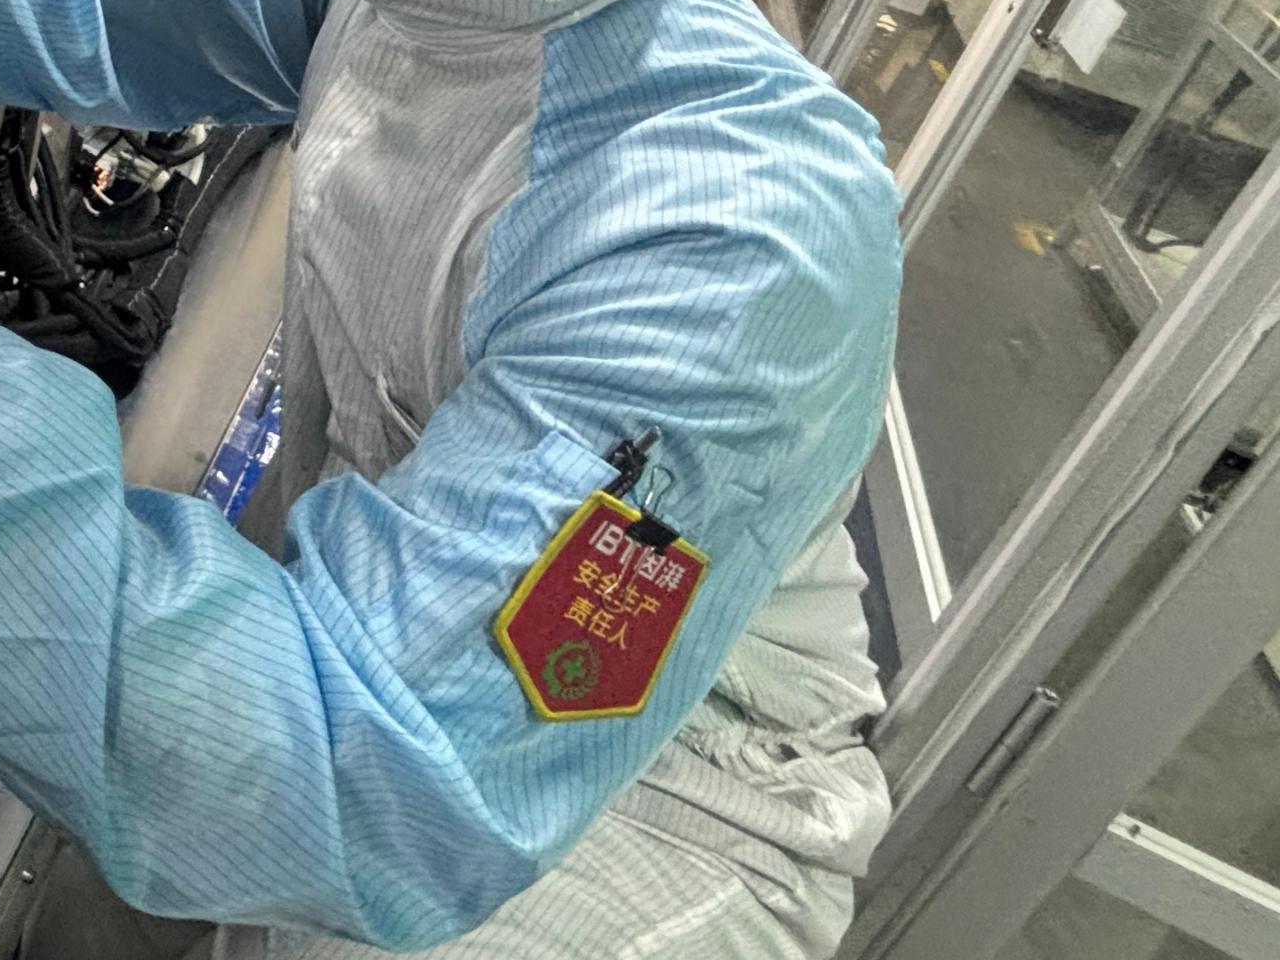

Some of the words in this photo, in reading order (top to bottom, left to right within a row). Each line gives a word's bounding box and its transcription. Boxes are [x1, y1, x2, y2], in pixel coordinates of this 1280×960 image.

[573, 559, 661, 617] 安全生产
[564, 596, 630, 651] 责任人
